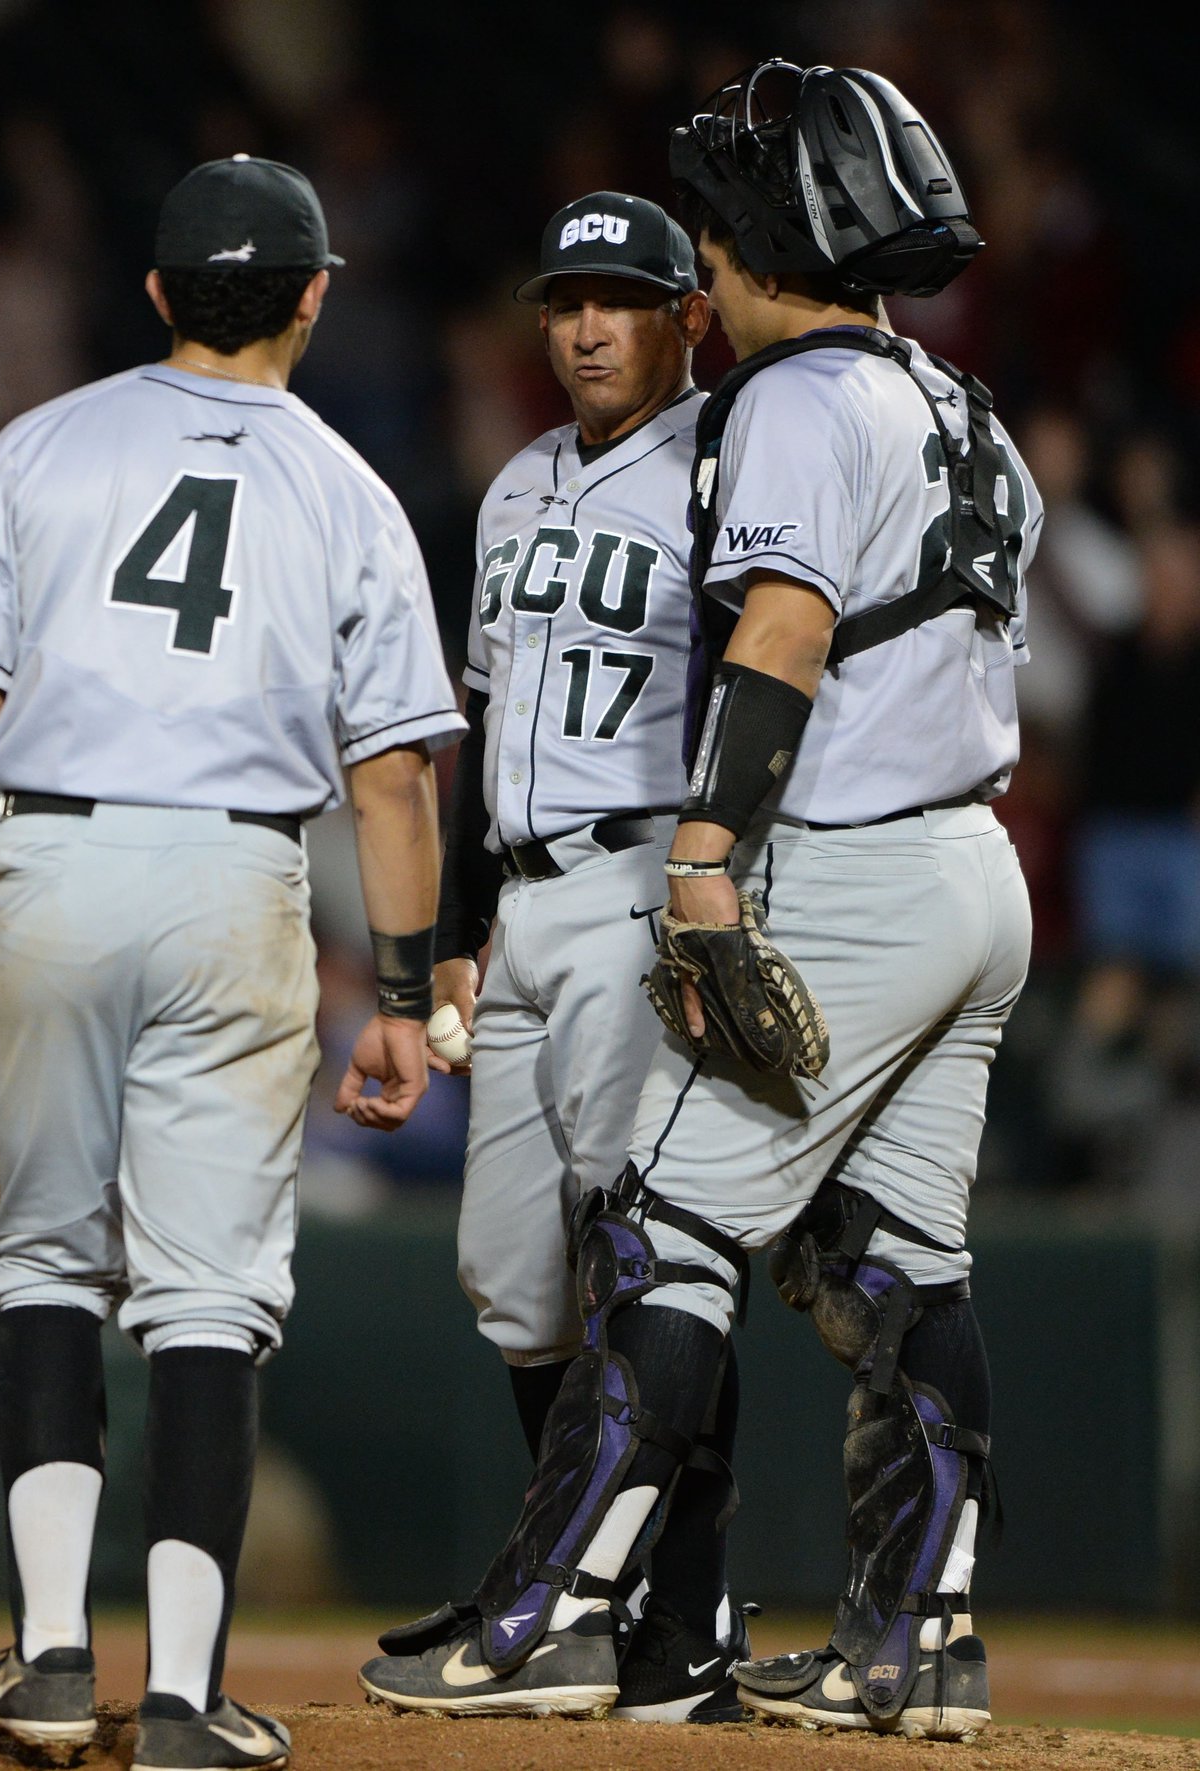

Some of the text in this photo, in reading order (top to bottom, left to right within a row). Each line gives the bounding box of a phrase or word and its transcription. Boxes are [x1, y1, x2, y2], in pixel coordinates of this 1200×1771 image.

[804, 174, 819, 220] EASTON
[559, 213, 630, 250] GCU
[723, 522, 803, 555] WAC
[104, 470, 245, 660] 4
[480, 526, 662, 637] GCU
[559, 645, 656, 742] 17
[867, 1664, 901, 1680] GCU
